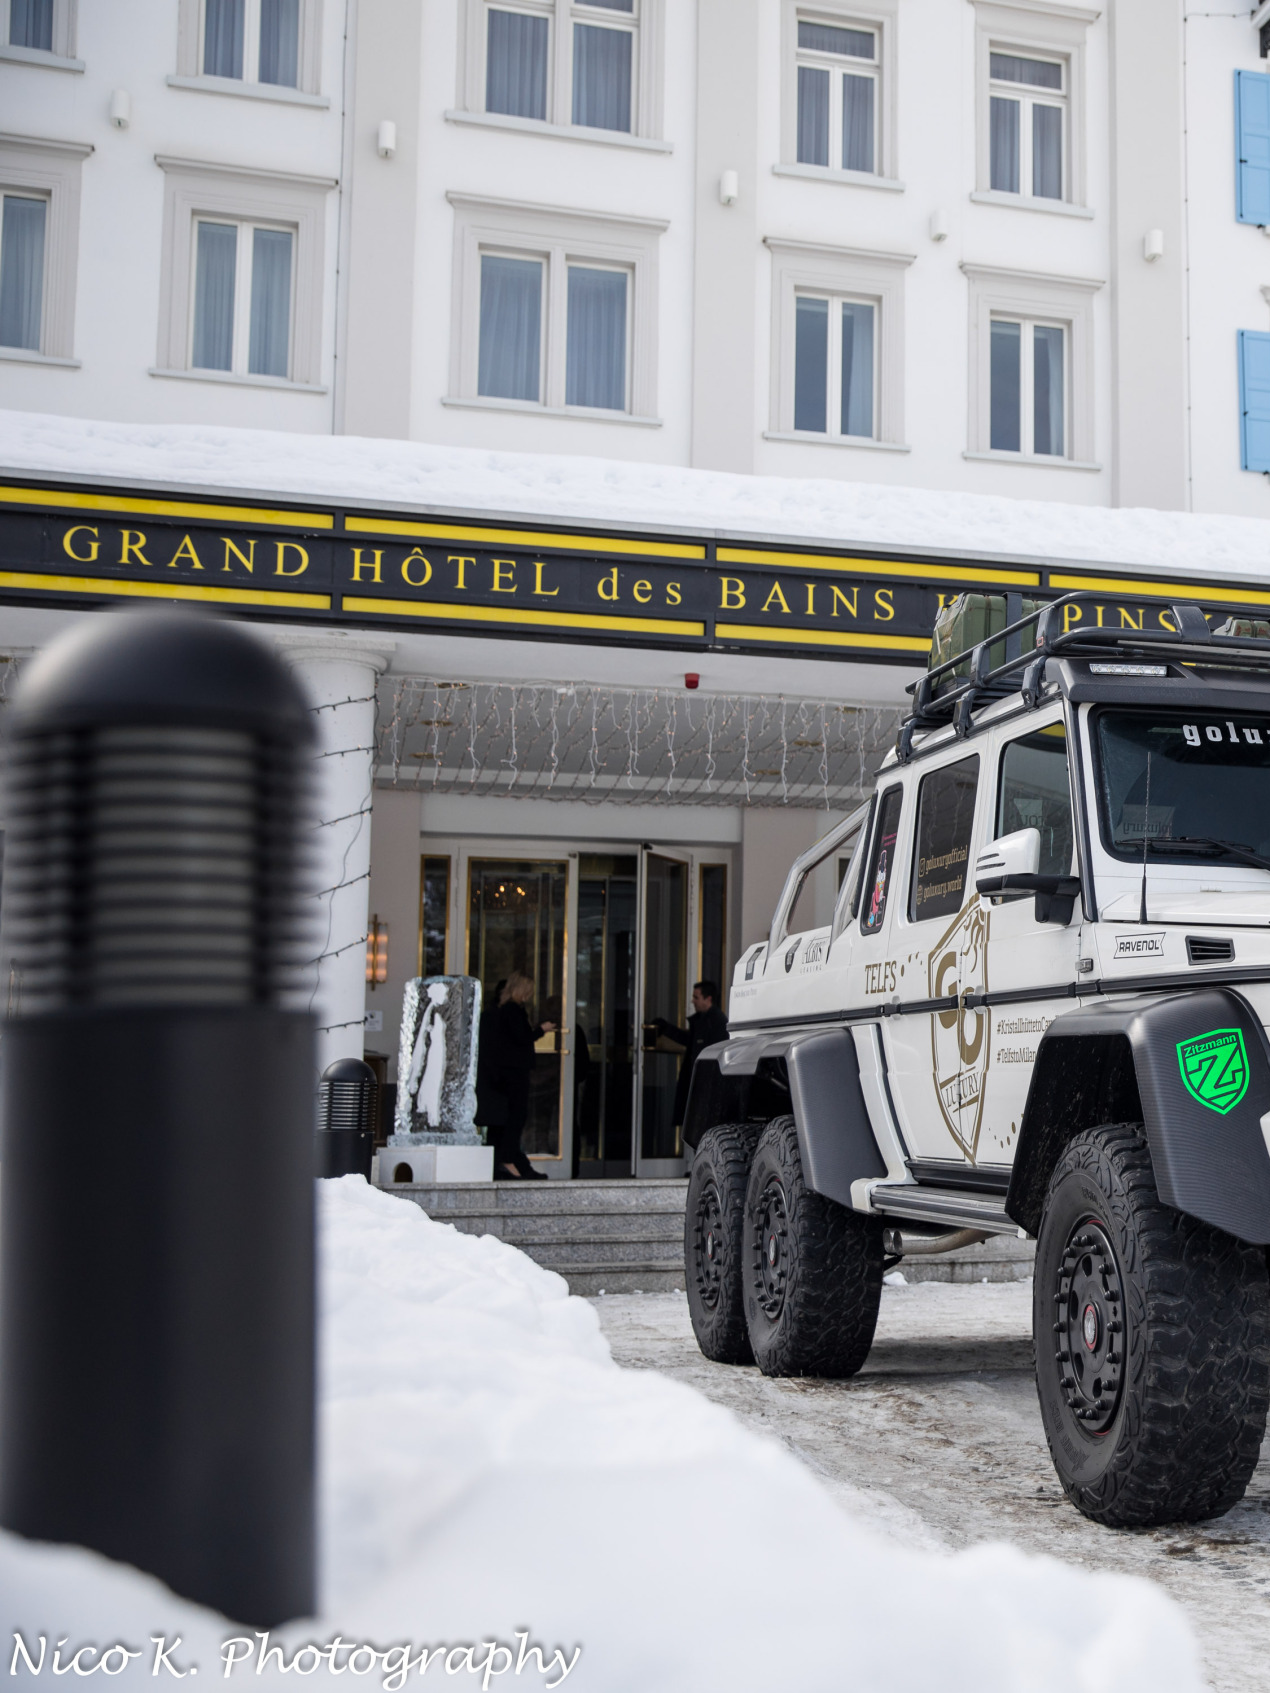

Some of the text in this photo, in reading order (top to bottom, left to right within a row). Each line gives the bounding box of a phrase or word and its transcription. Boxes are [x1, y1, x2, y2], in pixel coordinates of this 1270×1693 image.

[62, 525, 310, 577] GRAND
[349, 546, 560, 596] HÔTEL
[597, 567, 682, 605] des
[718, 576, 895, 621] BAINS
[1119, 939, 1160, 952] RAVENOL
[865, 960, 897, 994] TELFS
[1183, 1034, 1237, 1058] Zitzmann
